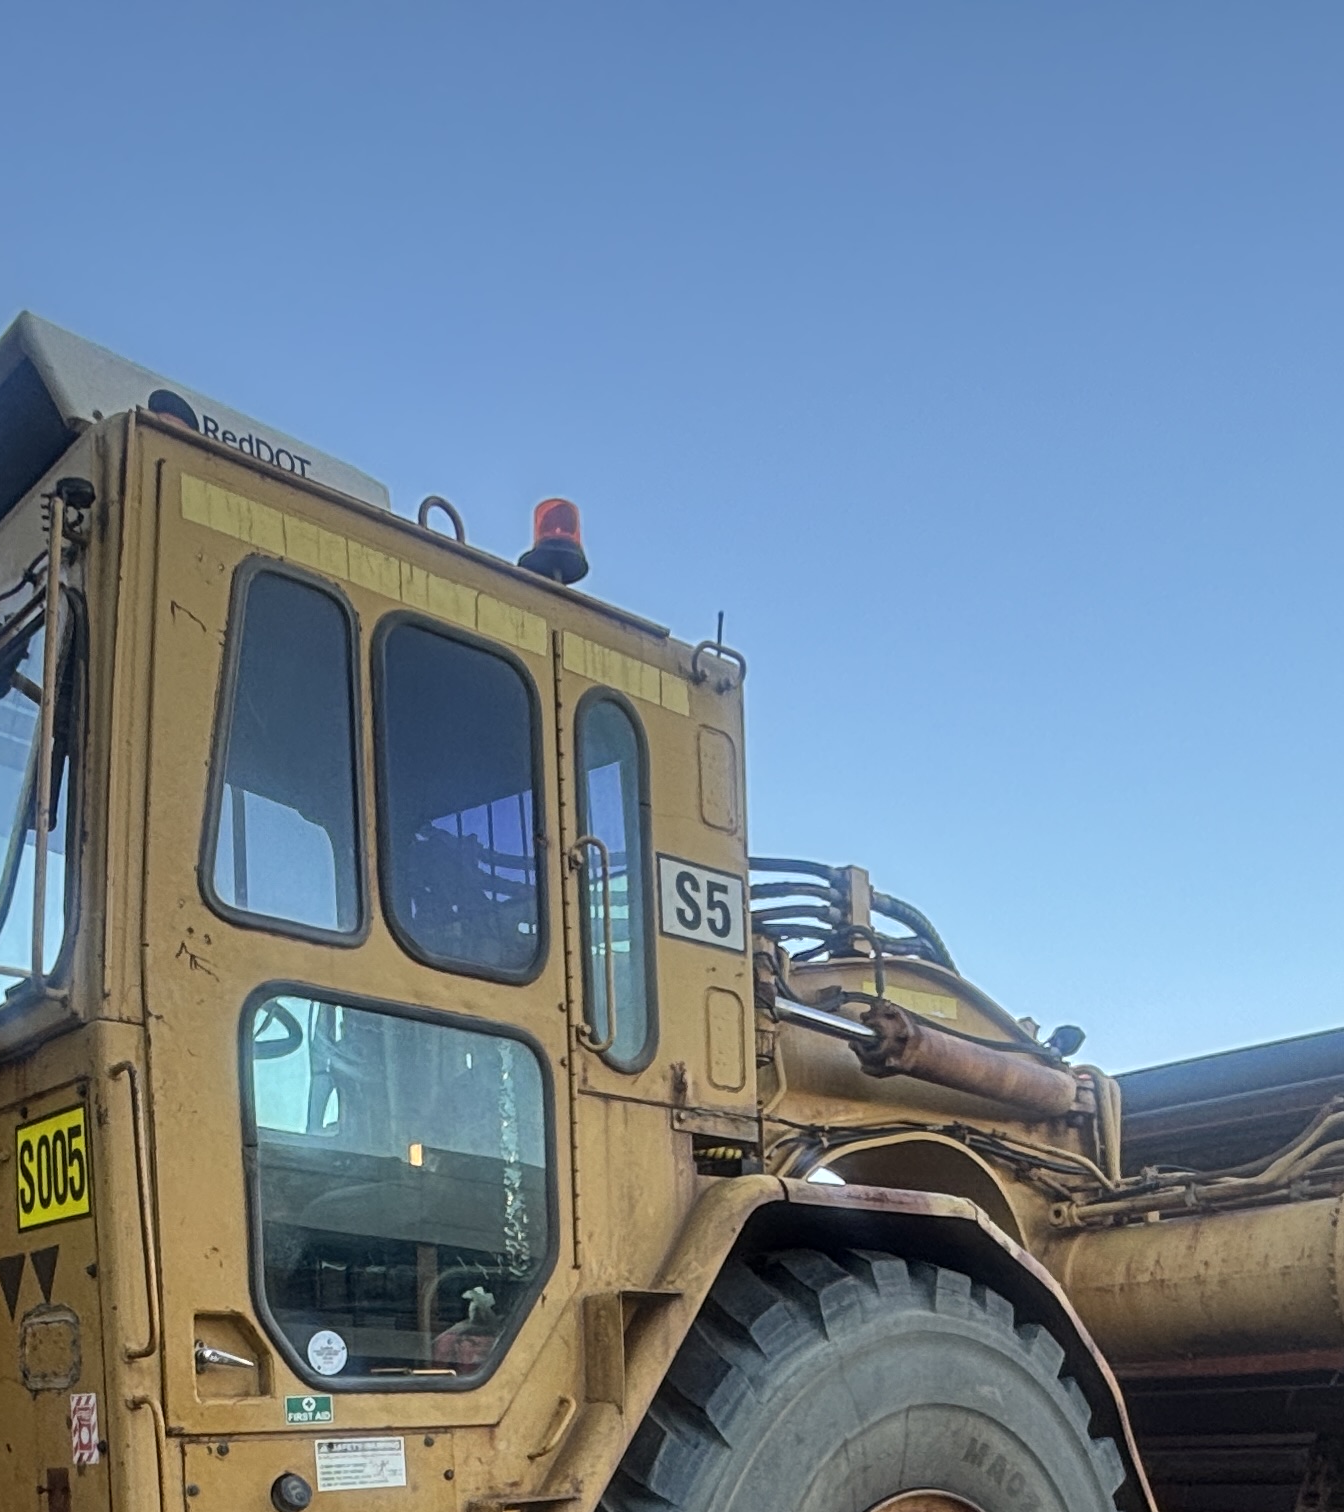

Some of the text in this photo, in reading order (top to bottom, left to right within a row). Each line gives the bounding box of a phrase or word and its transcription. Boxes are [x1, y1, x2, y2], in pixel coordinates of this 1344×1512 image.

[202, 415, 312, 479] RedDOT
[675, 870, 732, 939] S5
[18, 1123, 87, 1215] S005
[287, 1410, 331, 1422] FIRST AID
